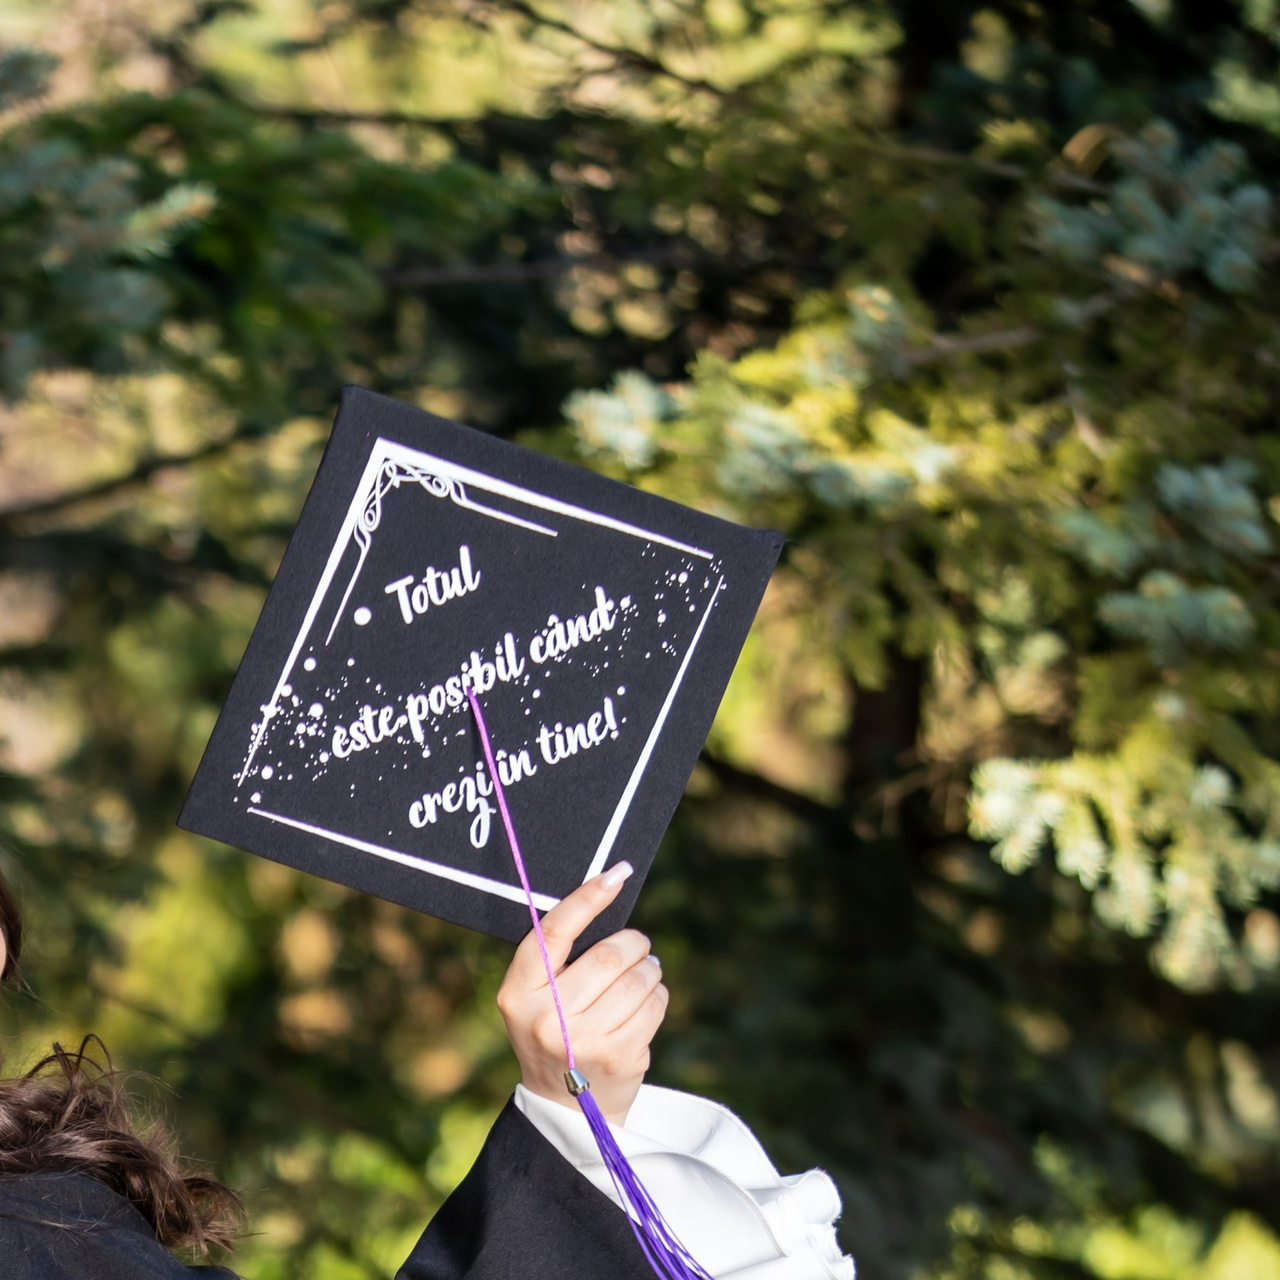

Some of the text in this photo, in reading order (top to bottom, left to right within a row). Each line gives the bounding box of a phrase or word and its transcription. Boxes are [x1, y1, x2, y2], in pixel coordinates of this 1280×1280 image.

[385, 545, 481, 625] Totul
[331, 586, 616, 758] este posibil când
[408, 696, 620, 849] crezi în tine!
